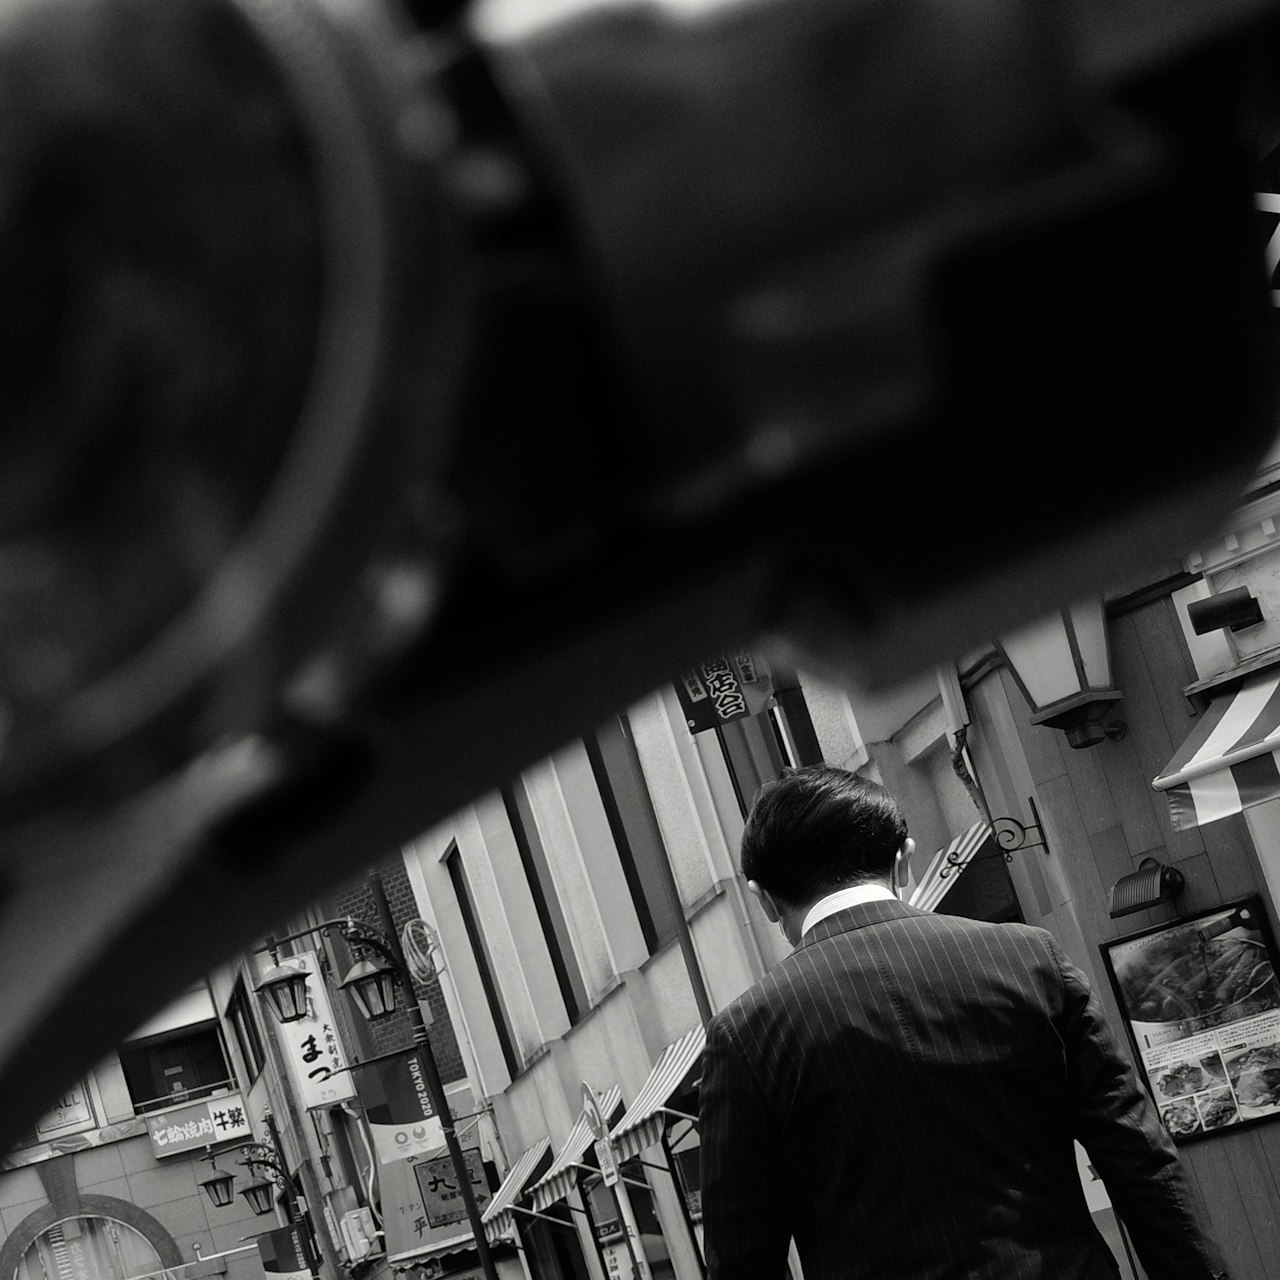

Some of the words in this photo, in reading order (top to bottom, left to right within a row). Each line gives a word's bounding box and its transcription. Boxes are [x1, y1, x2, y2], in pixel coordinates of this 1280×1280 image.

[407, 1057, 425, 1092] TOKYO
[416, 1090, 434, 1117] 2020
[152, 1116, 215, 1147] 七輪焼肉
[212, 1105, 247, 1132] 牛繁
